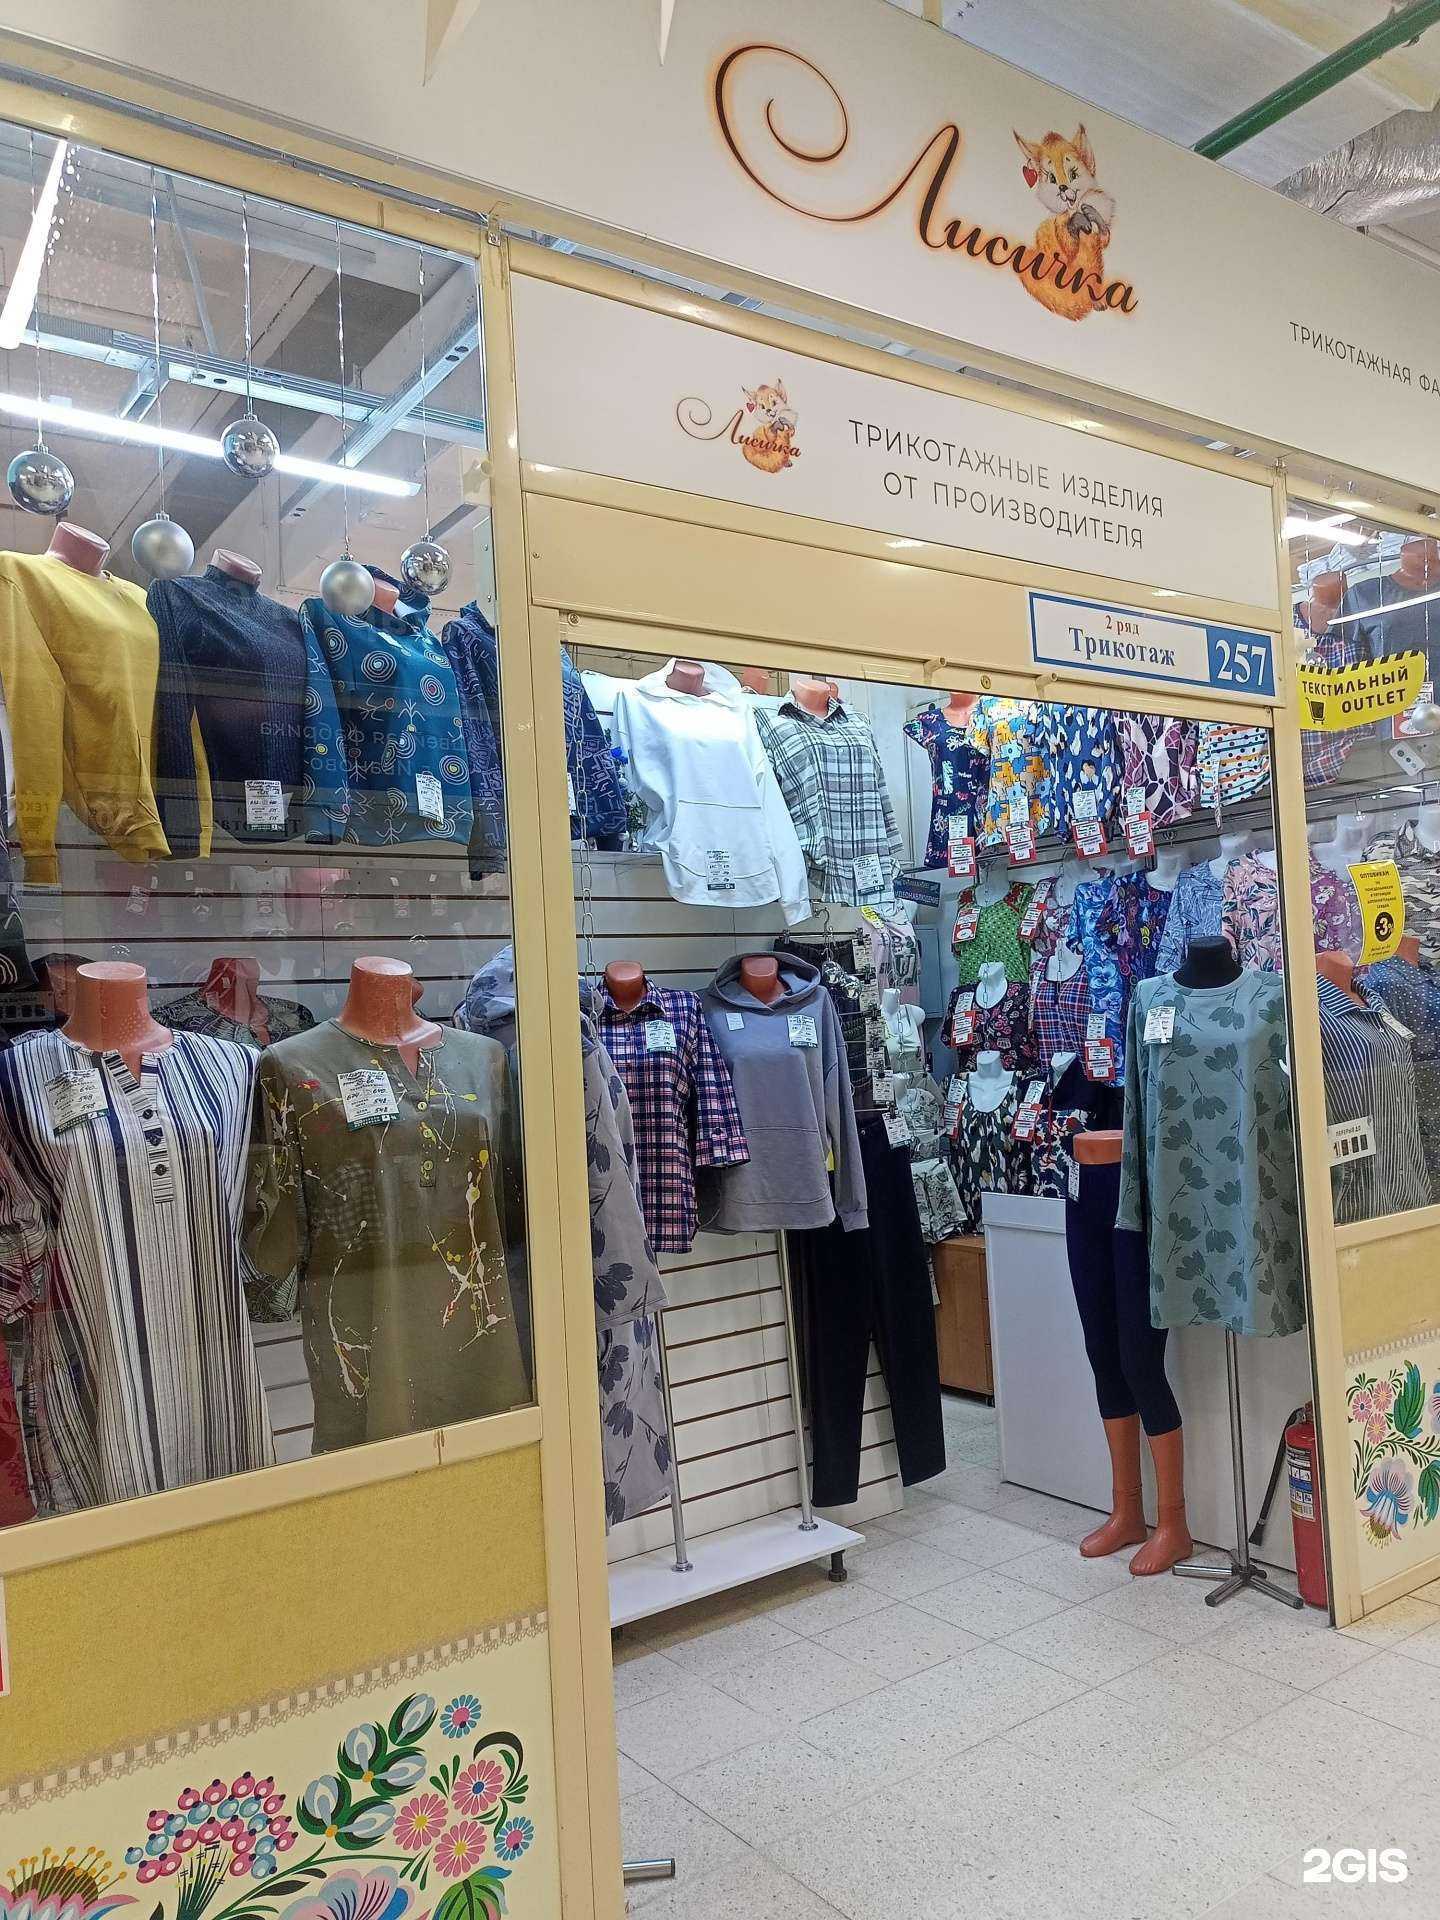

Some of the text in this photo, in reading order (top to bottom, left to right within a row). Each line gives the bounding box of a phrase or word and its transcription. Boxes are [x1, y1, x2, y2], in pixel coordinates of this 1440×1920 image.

[715, 45, 1139, 314] Лисичка
[1289, 321, 1411, 385] ТРИКОТАЖНАЯ
[677, 397, 801, 457] Лисичка
[849, 419, 1164, 517] ТРИКОТАЖНЫЕ ИЗДЕЛИЯ
[883, 472, 1144, 549] ОТ ПРОИЗВОДИТЕЛЯ
[1069, 627, 1176, 667] Трикотаж
[1105, 614, 1140, 637] 2 ряд
[1215, 639, 1267, 686] 257
[1302, 666, 1408, 697] ТЕКСТИЛЬНЫЙ
[1342, 688, 1406, 714] OUTLET
